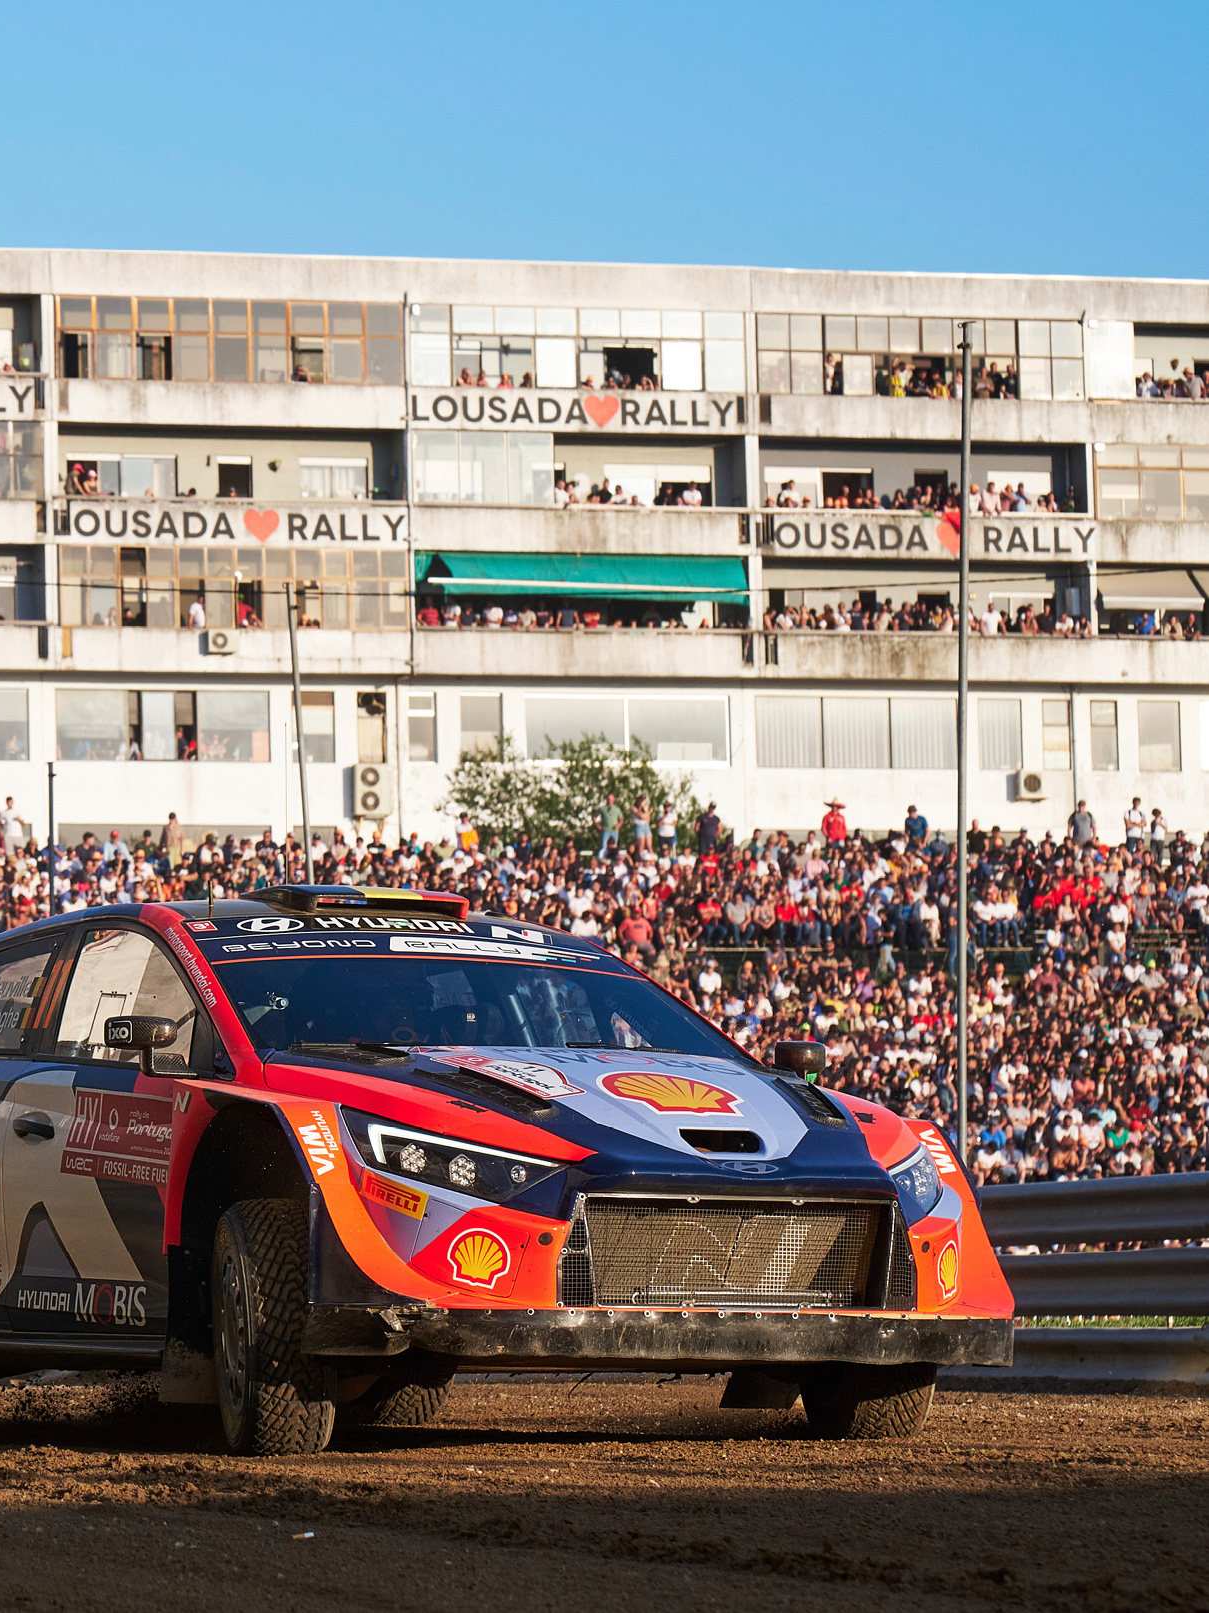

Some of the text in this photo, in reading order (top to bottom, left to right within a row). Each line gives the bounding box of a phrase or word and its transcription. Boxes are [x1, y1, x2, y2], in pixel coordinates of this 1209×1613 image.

[411, 395, 735, 427] LOUSADA RALLY
[288, 513, 406, 541] RALLY
[983, 526, 1096, 553] RALLY
[314, 917, 549, 945] HYUNDAI N
[222, 939, 521, 955] BEYOND RALLY
[164, 926, 217, 1009] motorsport.hyundai.com
[538, 1053, 746, 1076] MOBIS
[174, 1091, 192, 1113] N
[98, 1131, 120, 1142] vodafone
[126, 1119, 172, 1142] Portuga
[311, 1110, 339, 1151] HYUNDAI
[65, 1156, 93, 1171] WRC
[103, 1160, 150, 1180] FOSSIL-FREE
[365, 1175, 421, 1213] PIRELLI
[17, 1282, 147, 1327] HYUNDAI MOBIS
